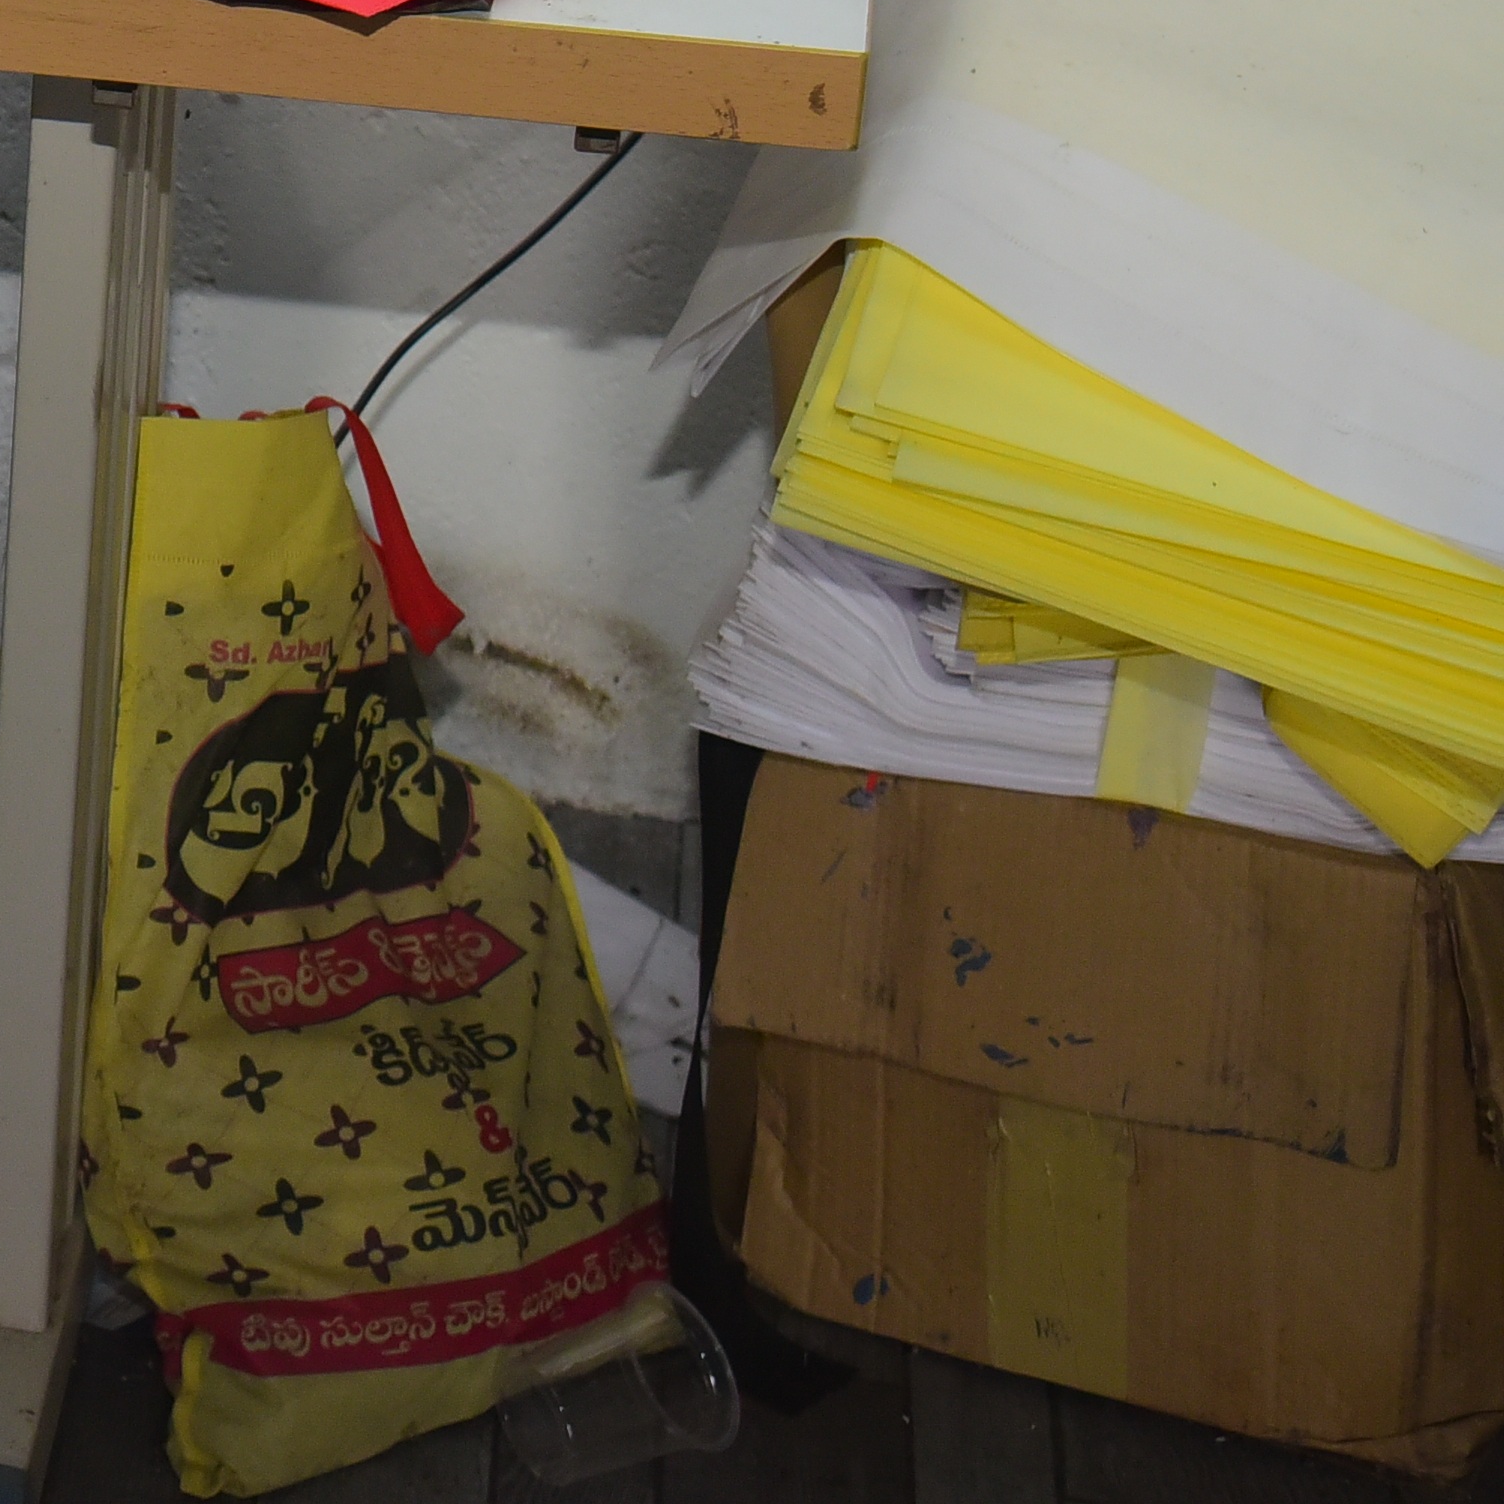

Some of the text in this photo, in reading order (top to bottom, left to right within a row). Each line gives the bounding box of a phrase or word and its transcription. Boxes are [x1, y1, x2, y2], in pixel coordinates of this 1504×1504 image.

[209, 640, 257, 665] Sd.
[231, 946, 369, 1019] సారీస్
[473, 1103, 513, 1155] &
